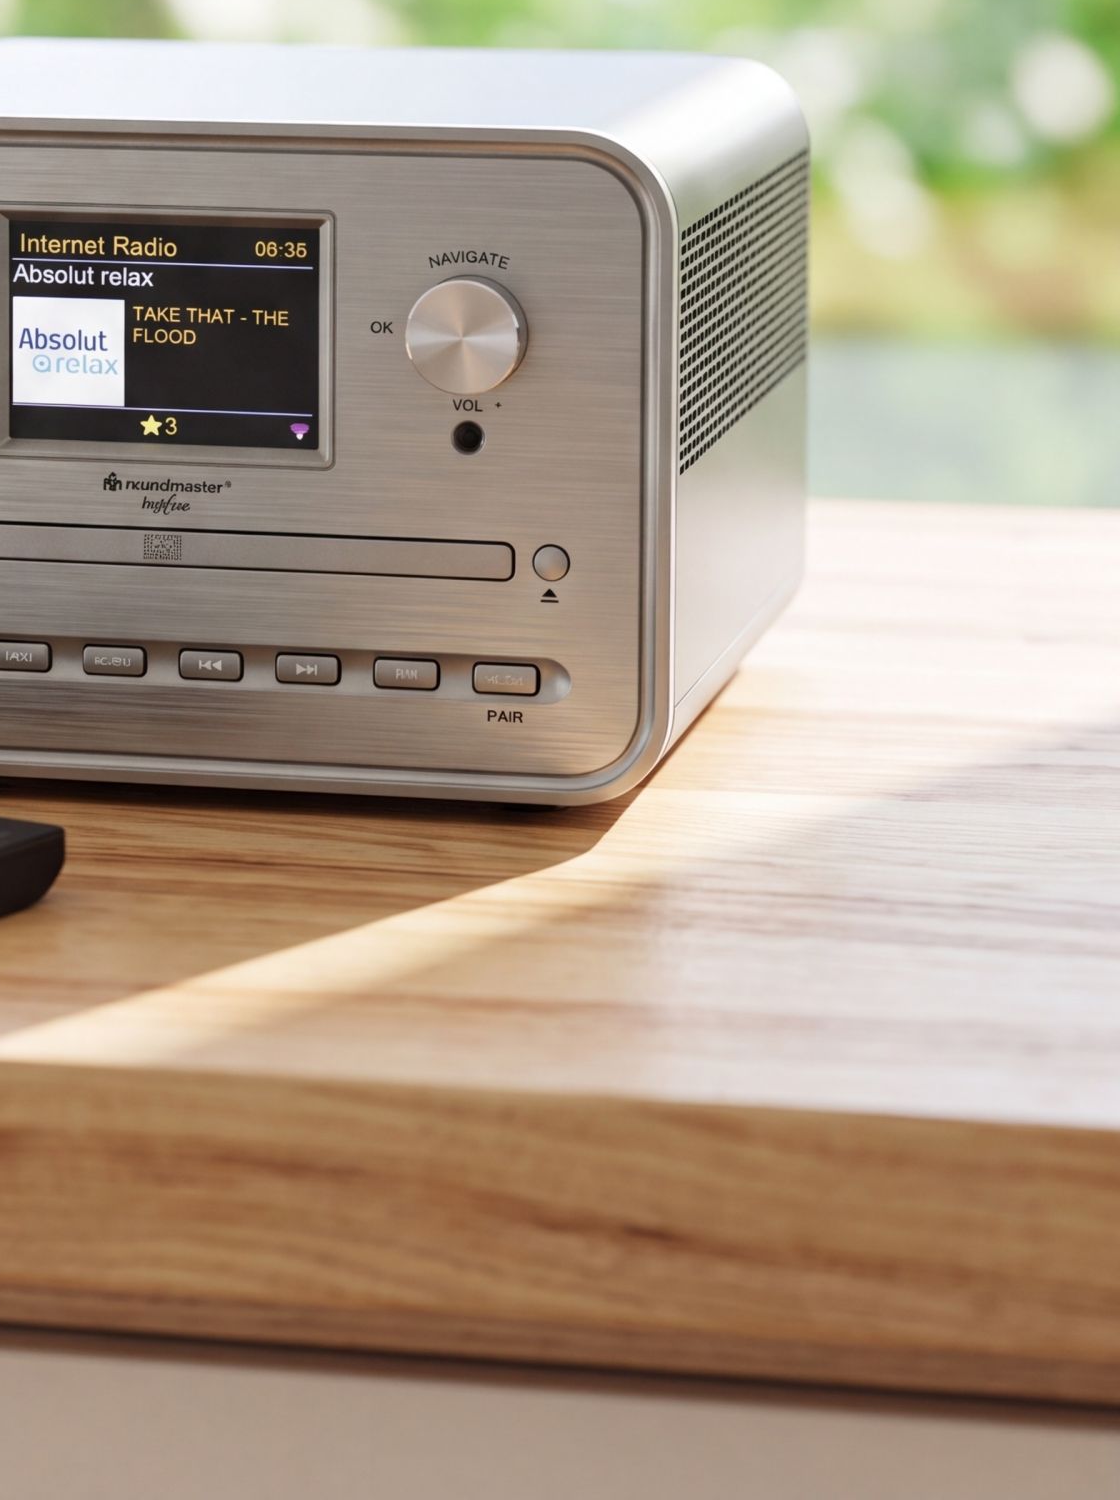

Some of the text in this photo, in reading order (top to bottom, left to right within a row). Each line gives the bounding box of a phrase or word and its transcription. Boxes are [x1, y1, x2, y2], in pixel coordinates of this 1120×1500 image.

[20, 233, 178, 258] Internet Radio
[428, 250, 510, 270] NAVIGATE
[13, 264, 154, 287] Absolut relax
[133, 306, 181, 323] TAKE
[186, 308, 235, 324] THAT
[252, 310, 289, 326] THE
[132, 328, 196, 345] FLOOD
[370, 321, 394, 334] OK
[18, 328, 108, 351] Absolut
[452, 399, 483, 412] VOL
[164, 417, 178, 435] 3
[487, 710, 523, 723] PAIR
